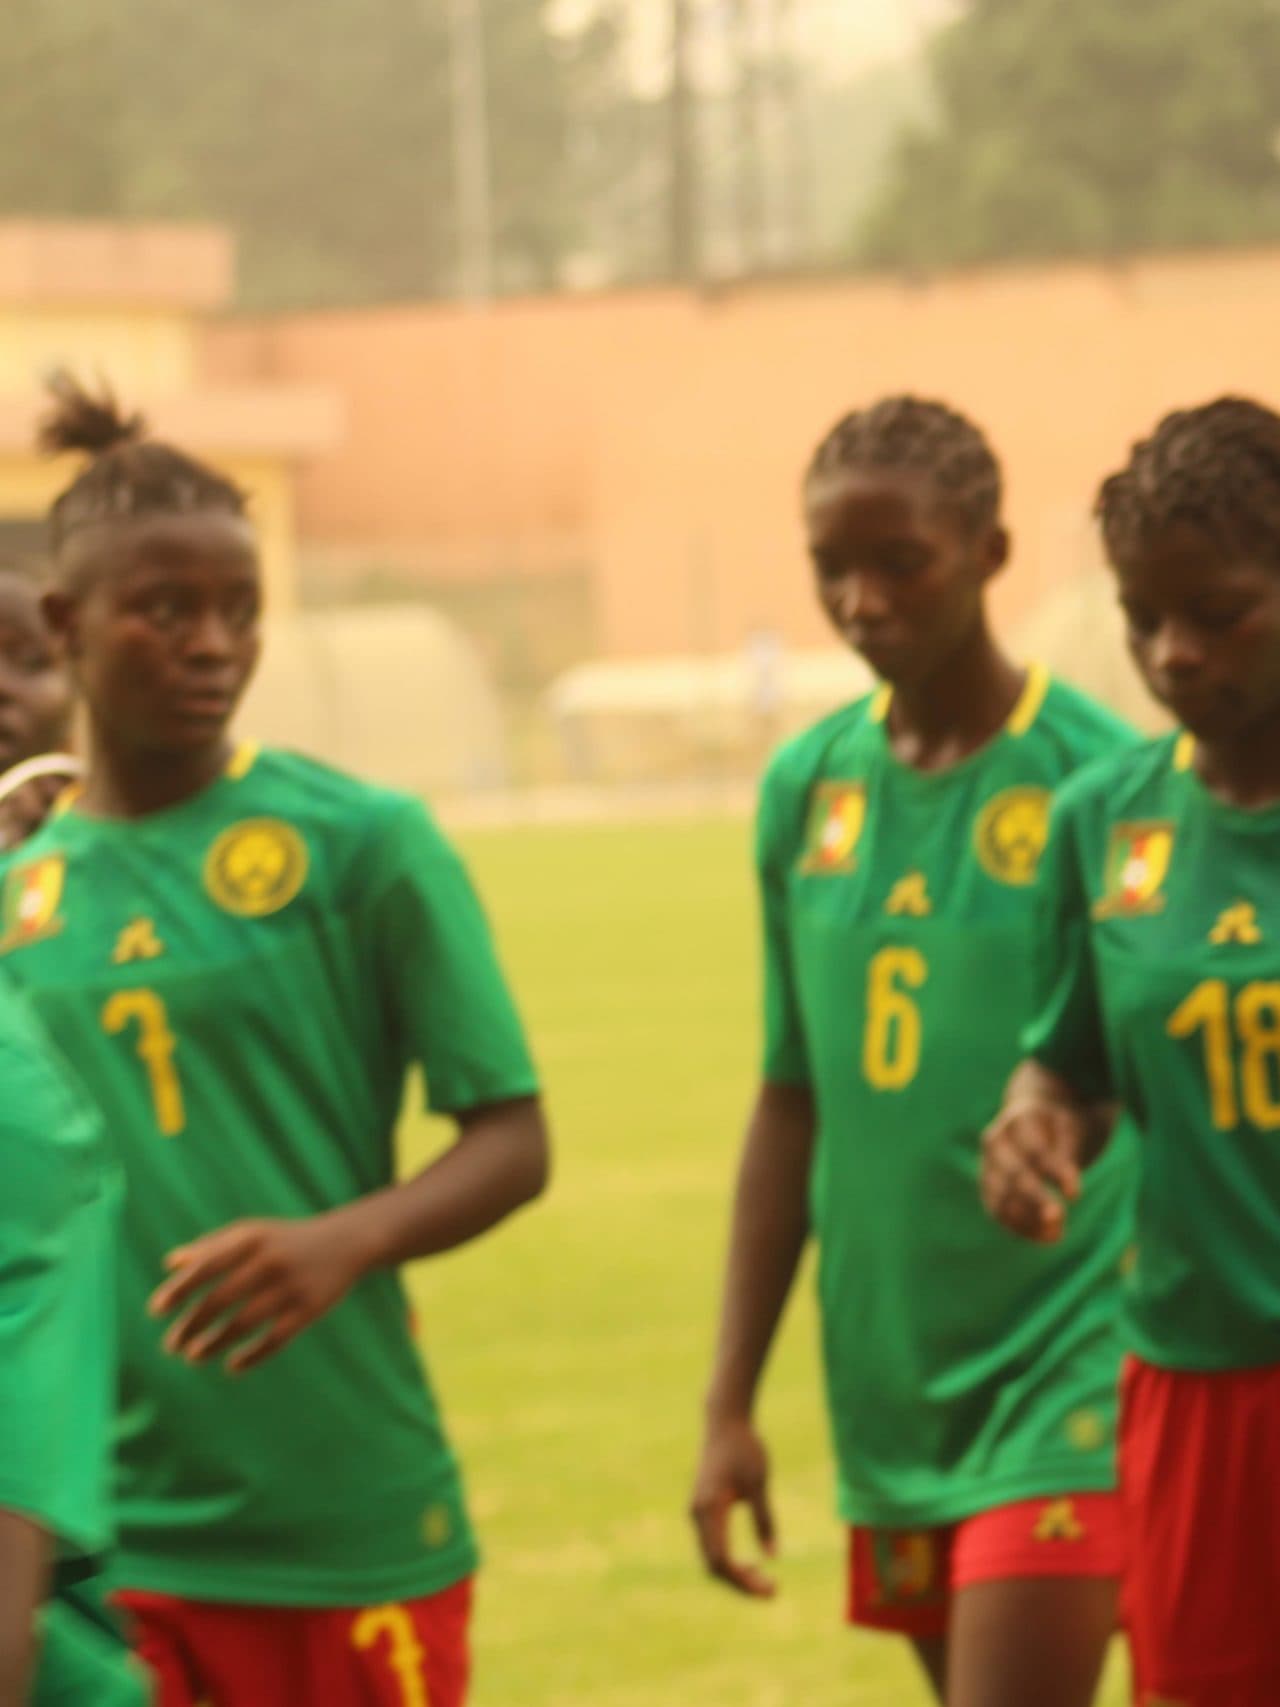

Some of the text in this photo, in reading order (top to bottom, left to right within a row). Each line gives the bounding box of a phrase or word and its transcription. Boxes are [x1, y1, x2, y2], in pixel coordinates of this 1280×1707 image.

[101, 987, 185, 1136] 7
[863, 947, 927, 1090] 6
[352, 1604, 430, 1706] 7
